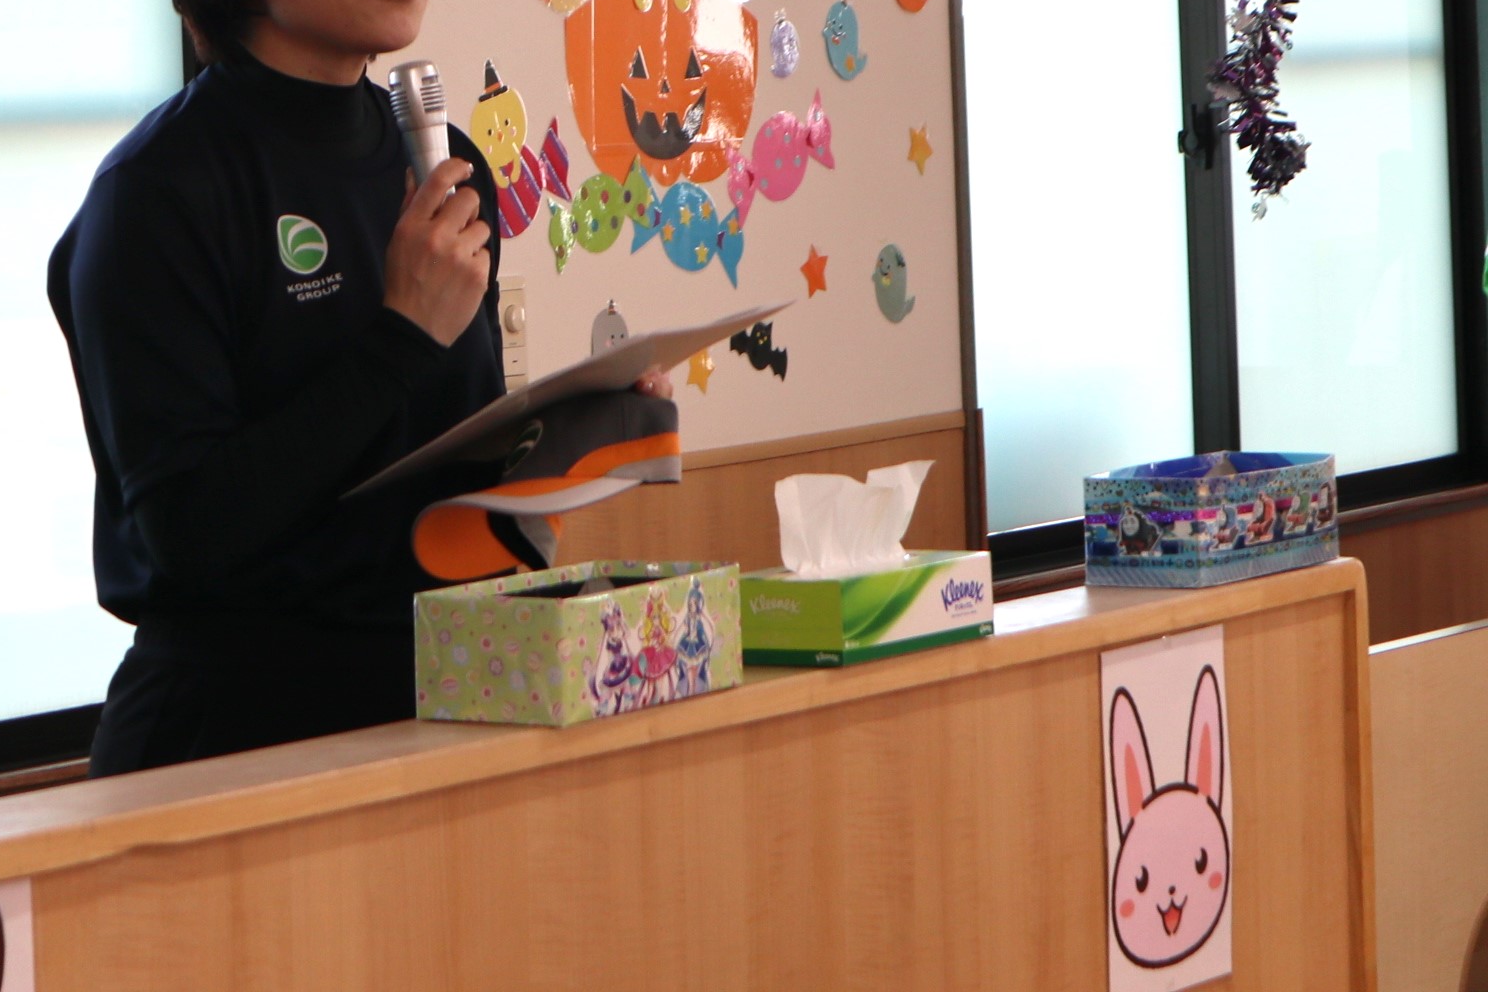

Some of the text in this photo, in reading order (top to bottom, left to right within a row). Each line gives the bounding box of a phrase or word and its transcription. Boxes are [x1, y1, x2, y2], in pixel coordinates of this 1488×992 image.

[286, 272, 343, 293] KONOIKE
[296, 283, 341, 301] GROUP
[749, 594, 801, 614] Kleenex
[940, 577, 984, 612] Kleenex
